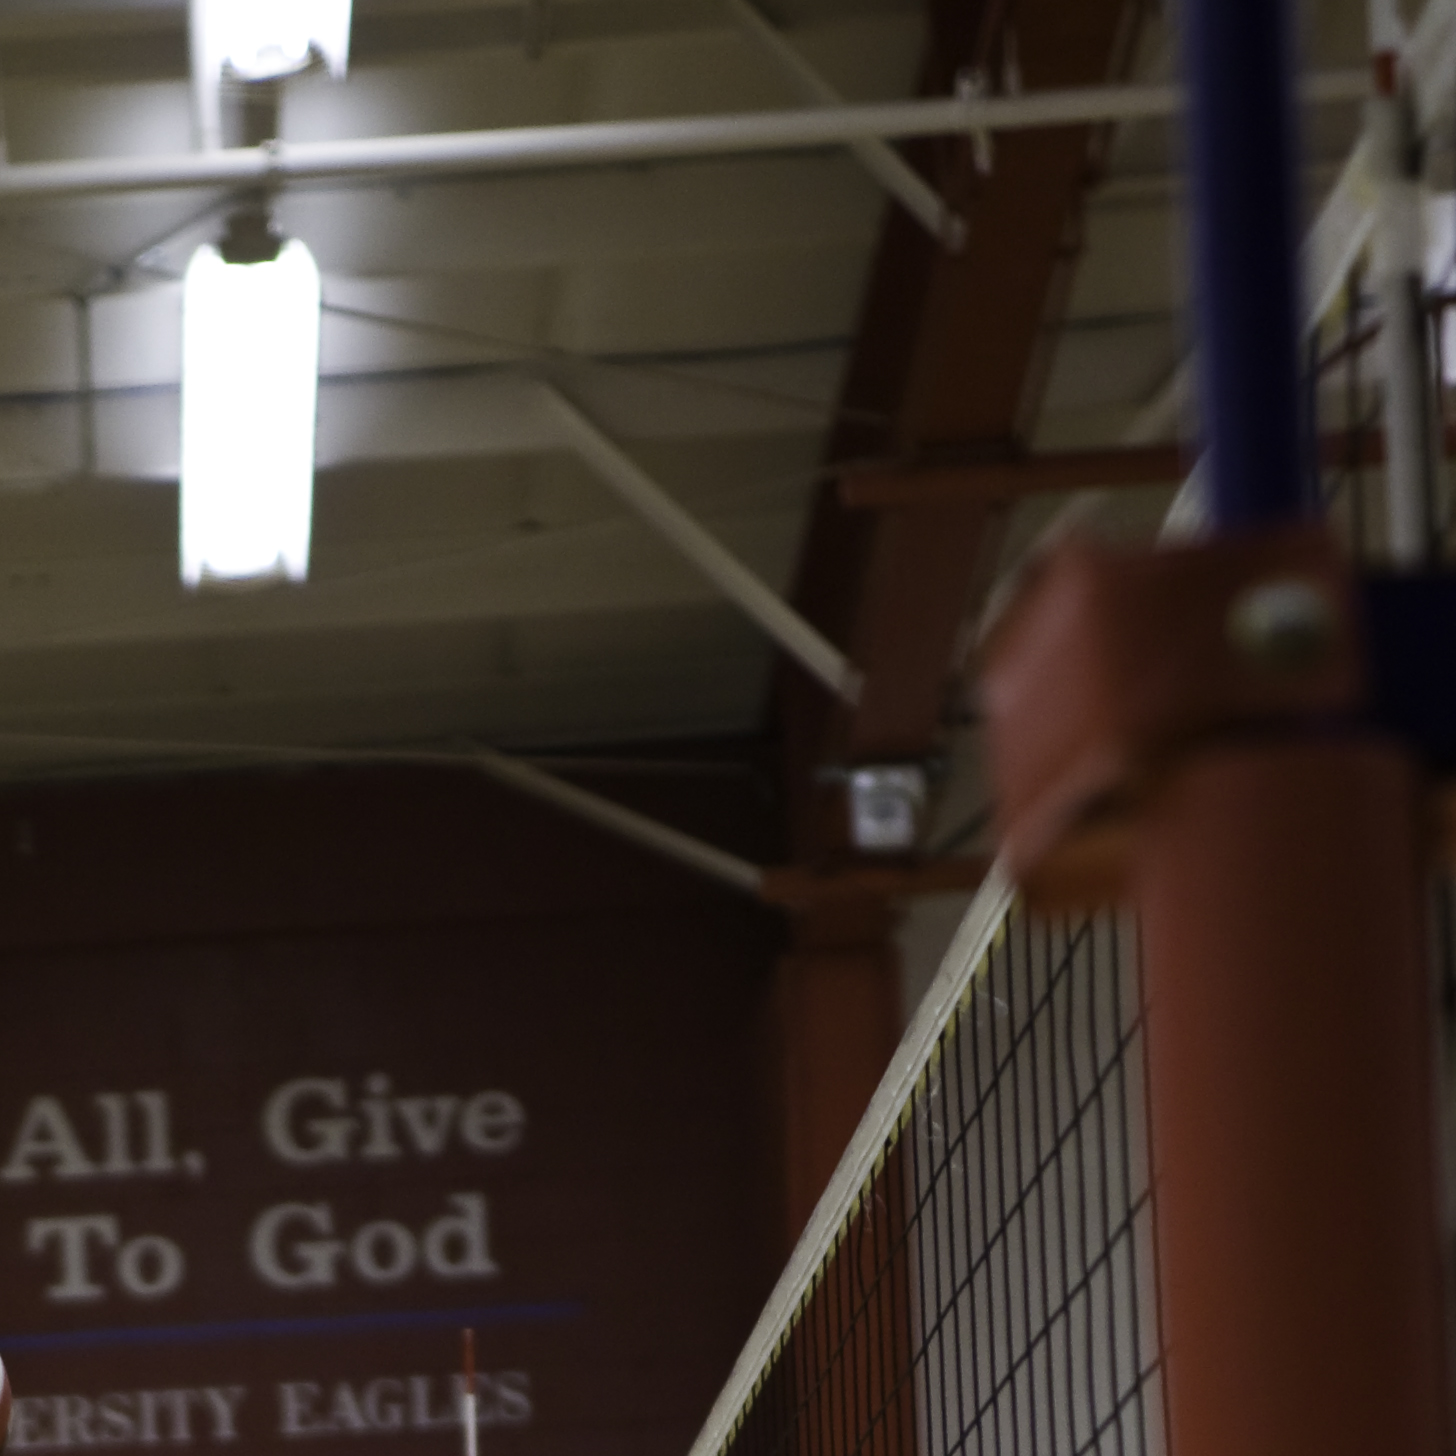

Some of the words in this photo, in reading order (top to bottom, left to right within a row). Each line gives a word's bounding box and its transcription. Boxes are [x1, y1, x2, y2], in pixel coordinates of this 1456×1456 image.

[260, 1070, 528, 1168] Give
[25, 1212, 186, 1303] To
[248, 1192, 500, 1292] God
[5, 1385, 247, 1455] ERSITY
[277, 1370, 534, 1440] EAGLES
